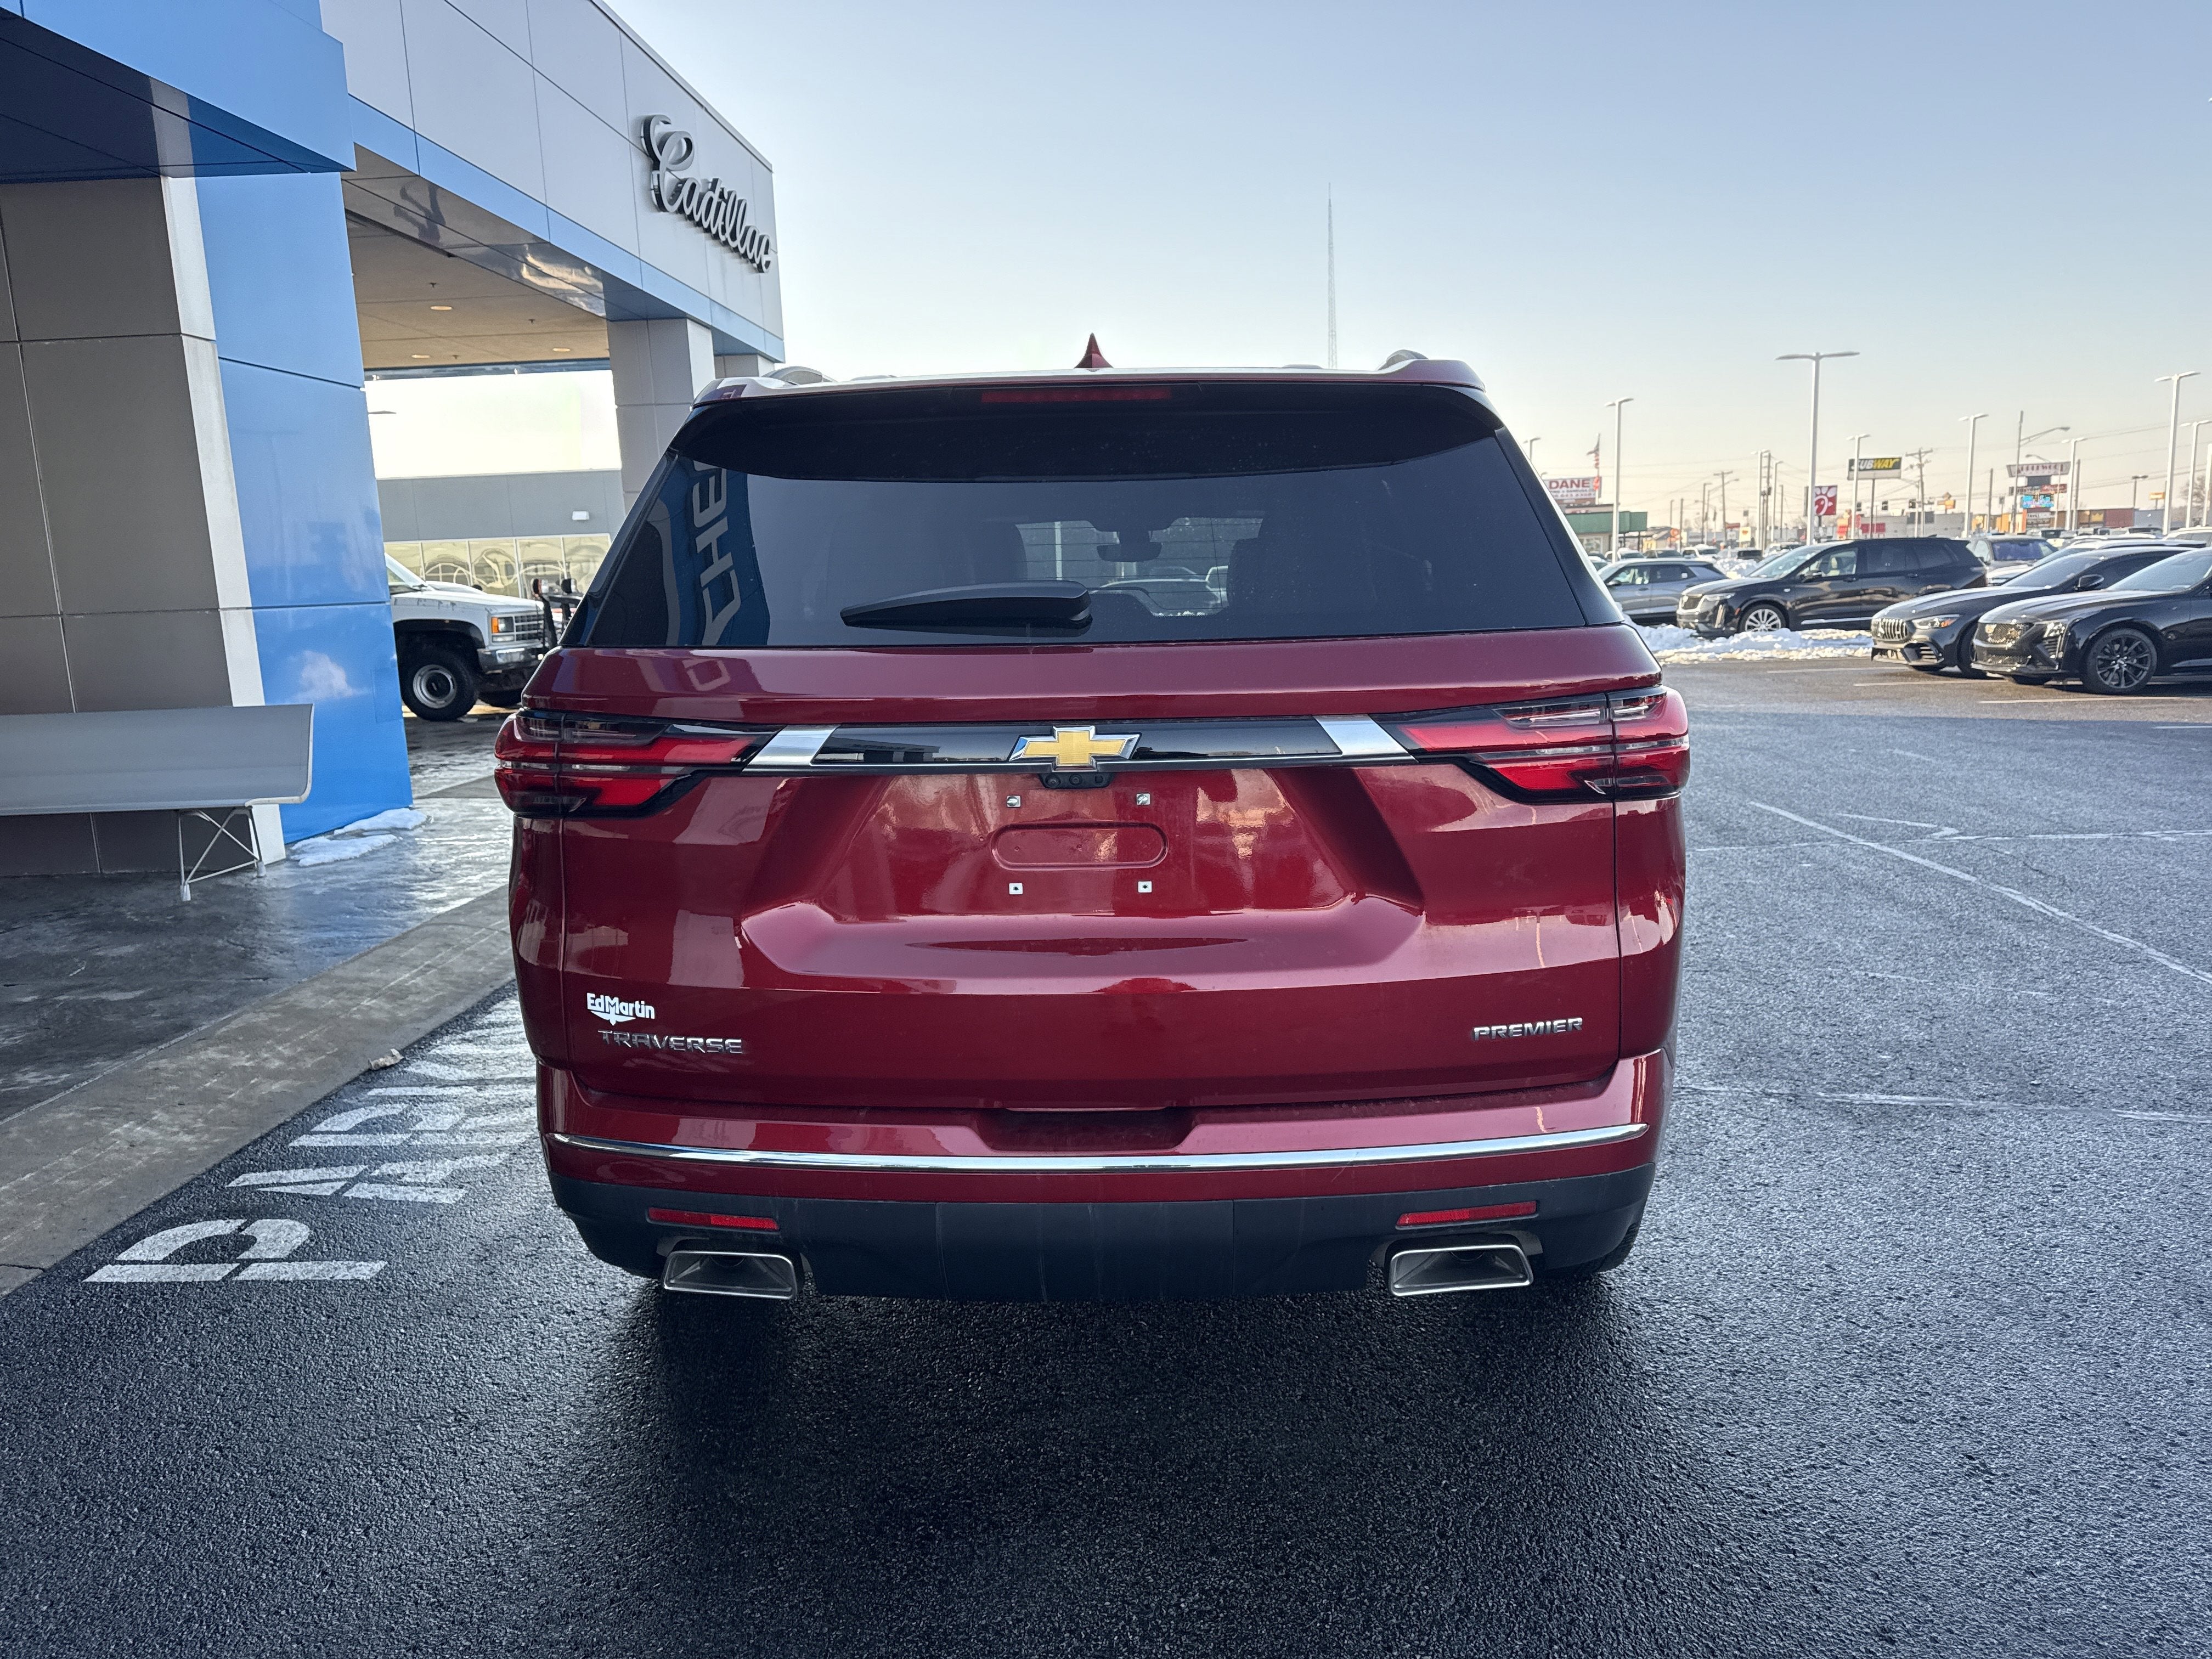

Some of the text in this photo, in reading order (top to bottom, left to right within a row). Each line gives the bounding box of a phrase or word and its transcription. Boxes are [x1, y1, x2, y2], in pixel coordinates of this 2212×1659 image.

[643, 114, 771, 273] Cadillac
[1850, 458, 1900, 470] UBWAY
[1549, 479, 1590, 489] DANE
[1471, 1017, 1583, 1041] PREMIER
[597, 1029, 744, 1054] TRAVERSE
